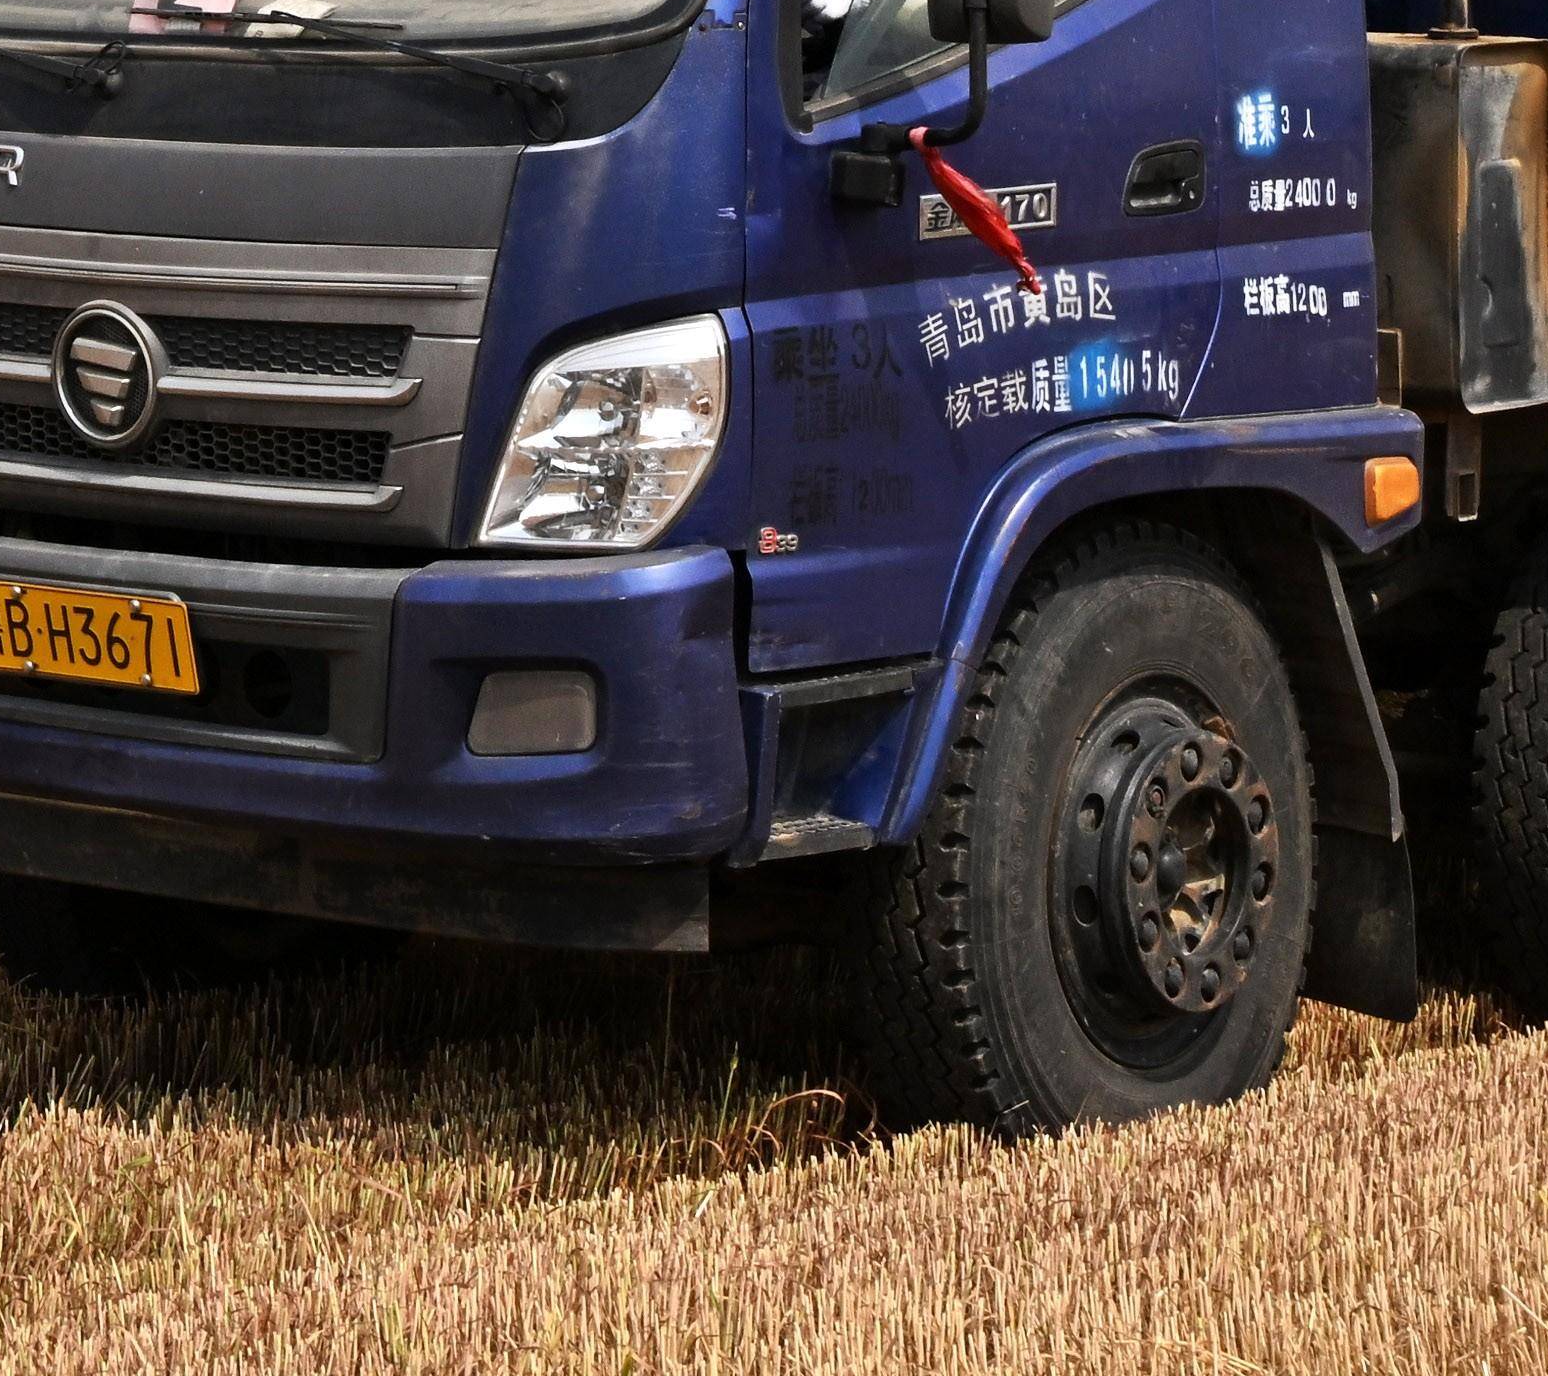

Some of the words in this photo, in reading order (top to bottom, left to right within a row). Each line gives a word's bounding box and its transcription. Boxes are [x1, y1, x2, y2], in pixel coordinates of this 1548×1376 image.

[918, 268, 1116, 368] 青岛市黄岛区
